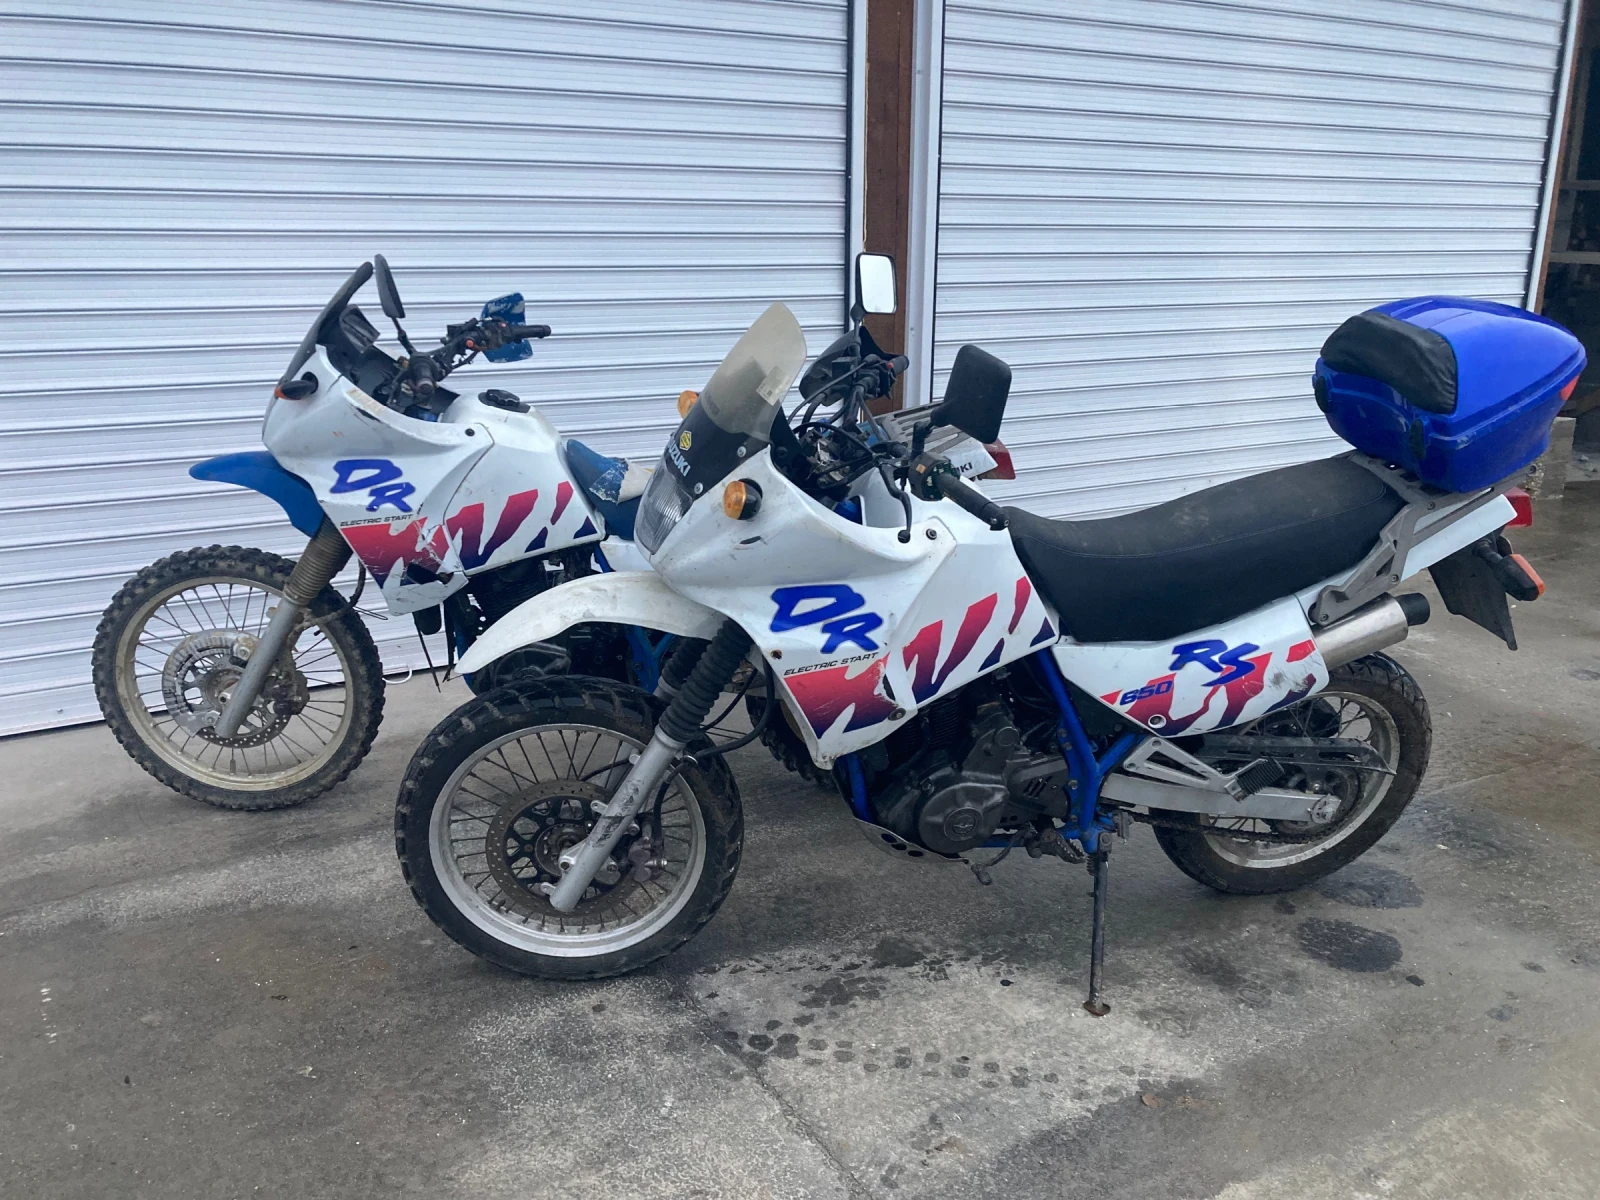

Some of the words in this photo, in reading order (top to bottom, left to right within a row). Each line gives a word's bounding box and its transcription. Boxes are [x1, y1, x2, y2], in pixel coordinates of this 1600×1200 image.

[667, 440, 691, 477] UZUKI
[330, 459, 415, 512] DR
[340, 517, 381, 527] ELECTRIC
[383, 513, 413, 523] START
[770, 584, 883, 654] DR
[784, 660, 839, 676] ELECTRIC
[841, 651, 879, 666] START
[1169, 639, 1260, 686] RS
[1120, 680, 1173, 706] 650
